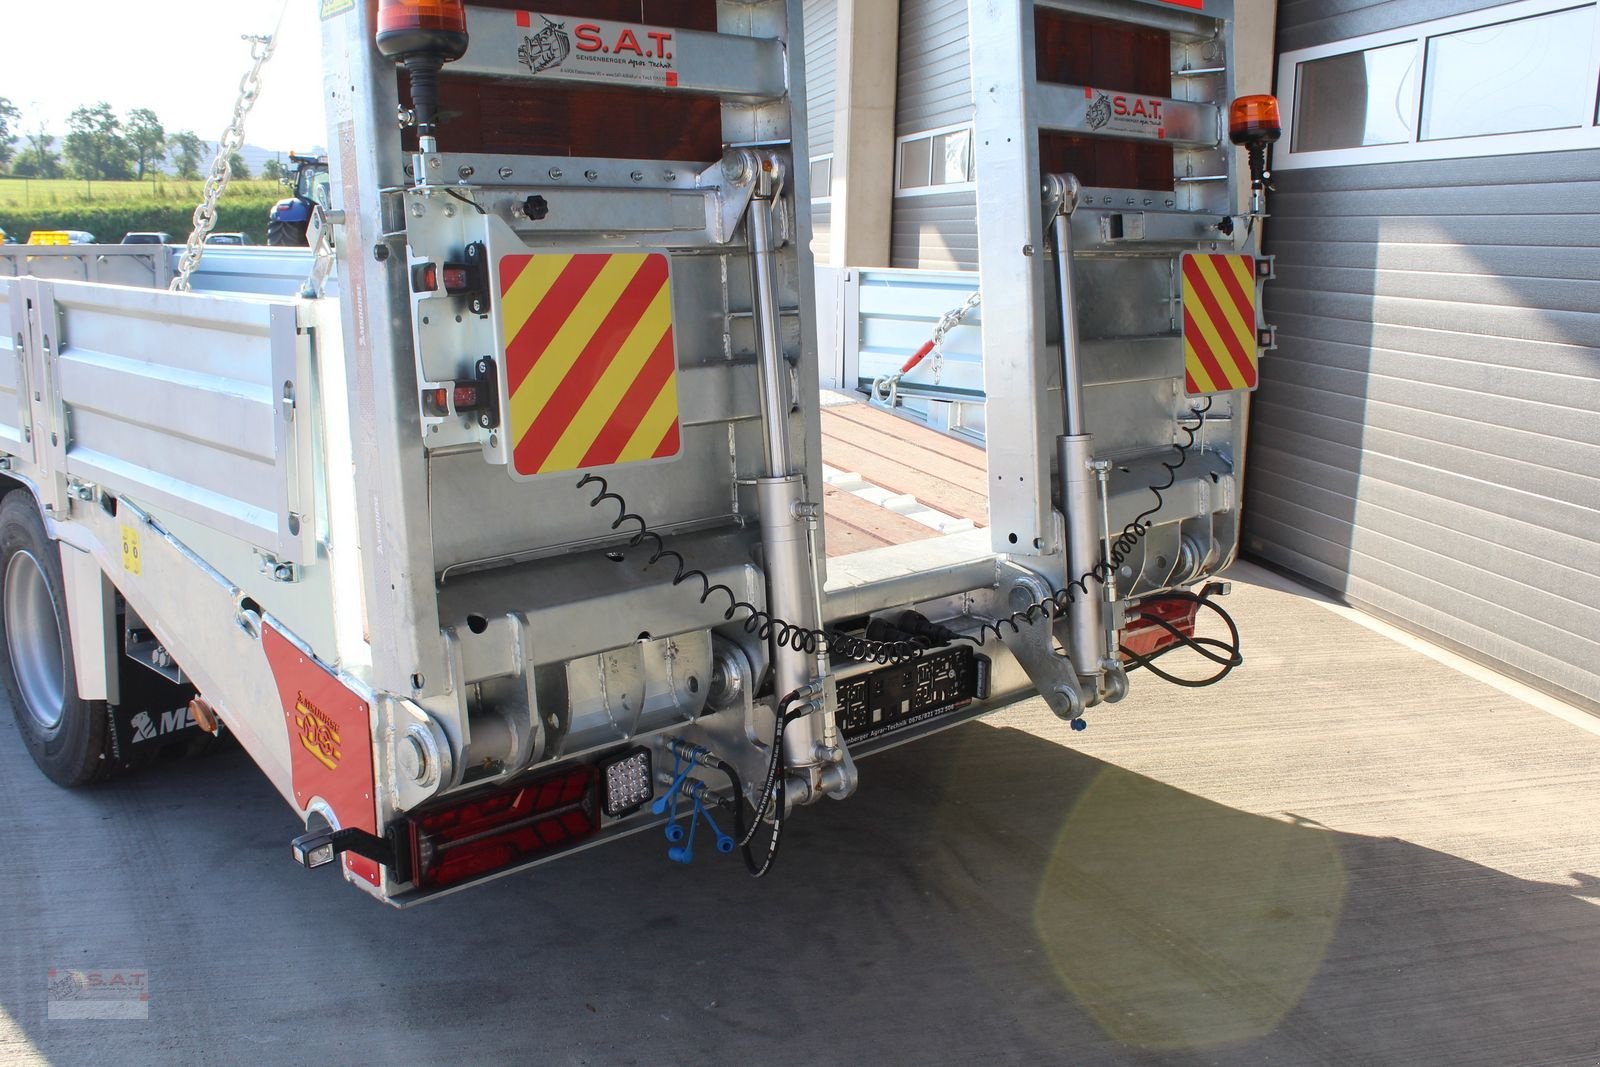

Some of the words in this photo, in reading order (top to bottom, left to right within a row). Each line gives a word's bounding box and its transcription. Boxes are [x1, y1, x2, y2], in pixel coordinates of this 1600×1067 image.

[574, 23, 673, 60] S.A.T.
[575, 54, 627, 64] SENSENBERGER
[1113, 95, 1162, 120] S.A.T.
